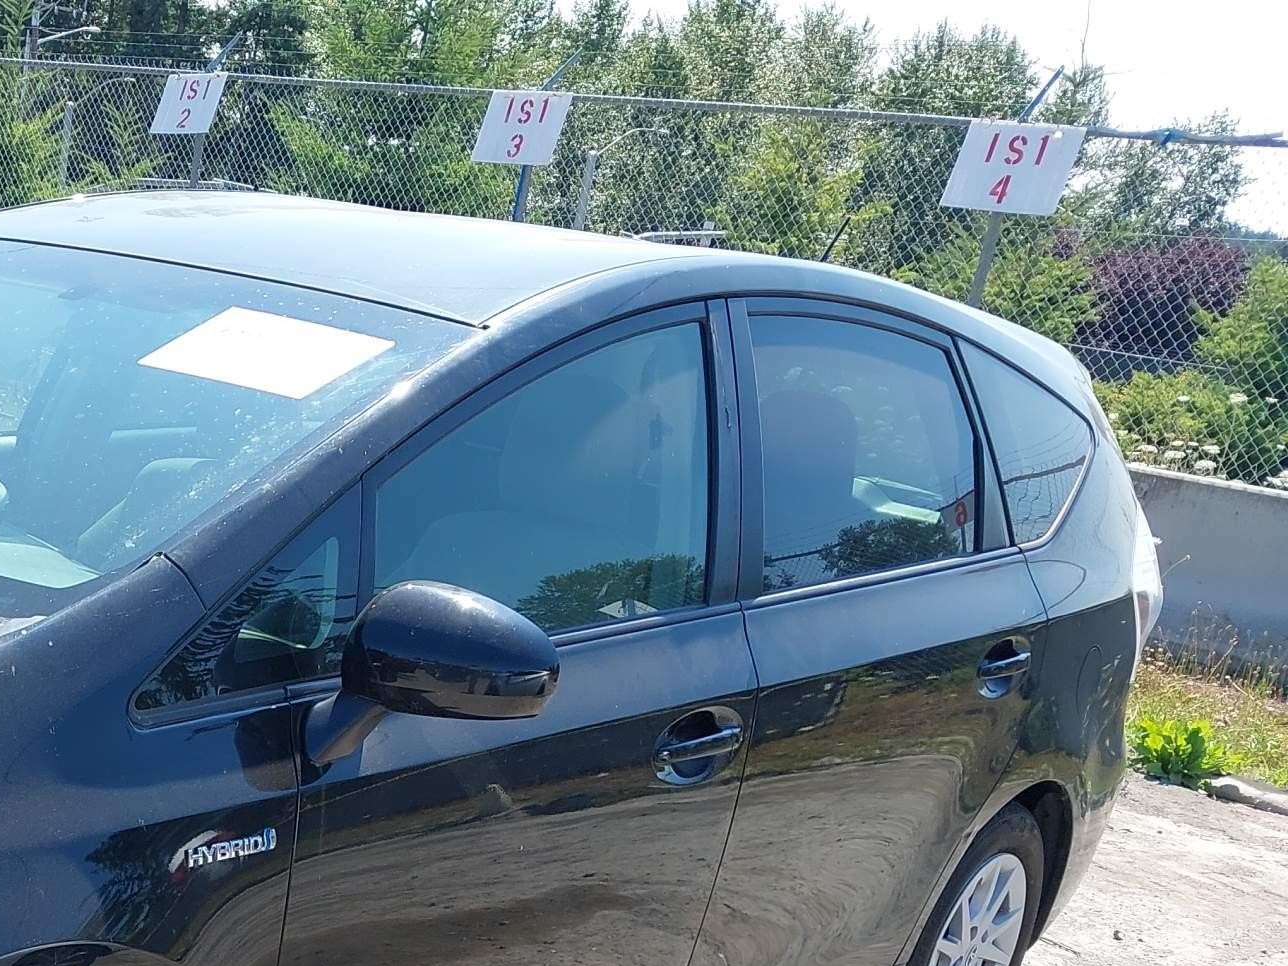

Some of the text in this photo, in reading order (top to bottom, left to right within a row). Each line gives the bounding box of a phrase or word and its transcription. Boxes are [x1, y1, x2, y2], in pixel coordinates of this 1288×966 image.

[176, 108, 191, 129] 2
[507, 133, 524, 158] 3
[988, 174, 1012, 204] 4
[187, 833, 264, 868] HYBRID
